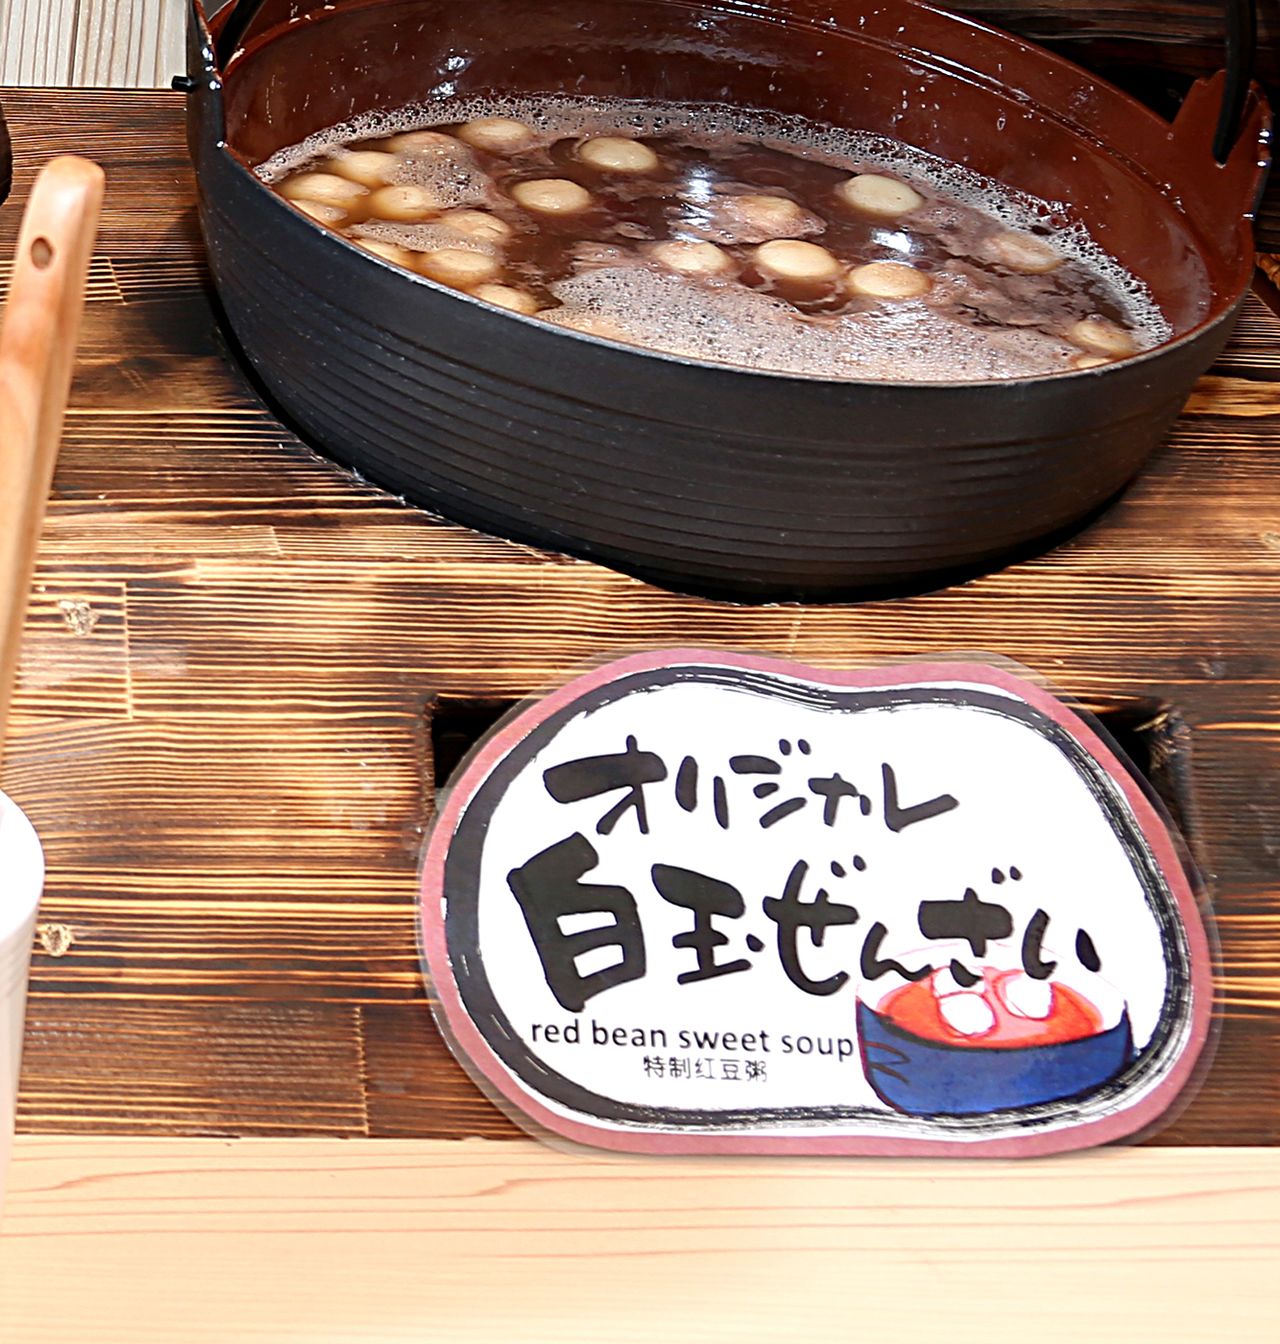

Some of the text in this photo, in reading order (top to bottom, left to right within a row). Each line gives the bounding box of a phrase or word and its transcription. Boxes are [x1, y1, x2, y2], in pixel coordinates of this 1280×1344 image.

[543, 735, 959, 834] オリジナル
[506, 832, 1101, 1013] 白玉ぜんざい
[531, 1018, 854, 1062] red bean sweet soup
[643, 1055, 768, 1082] 特制红豆粥
